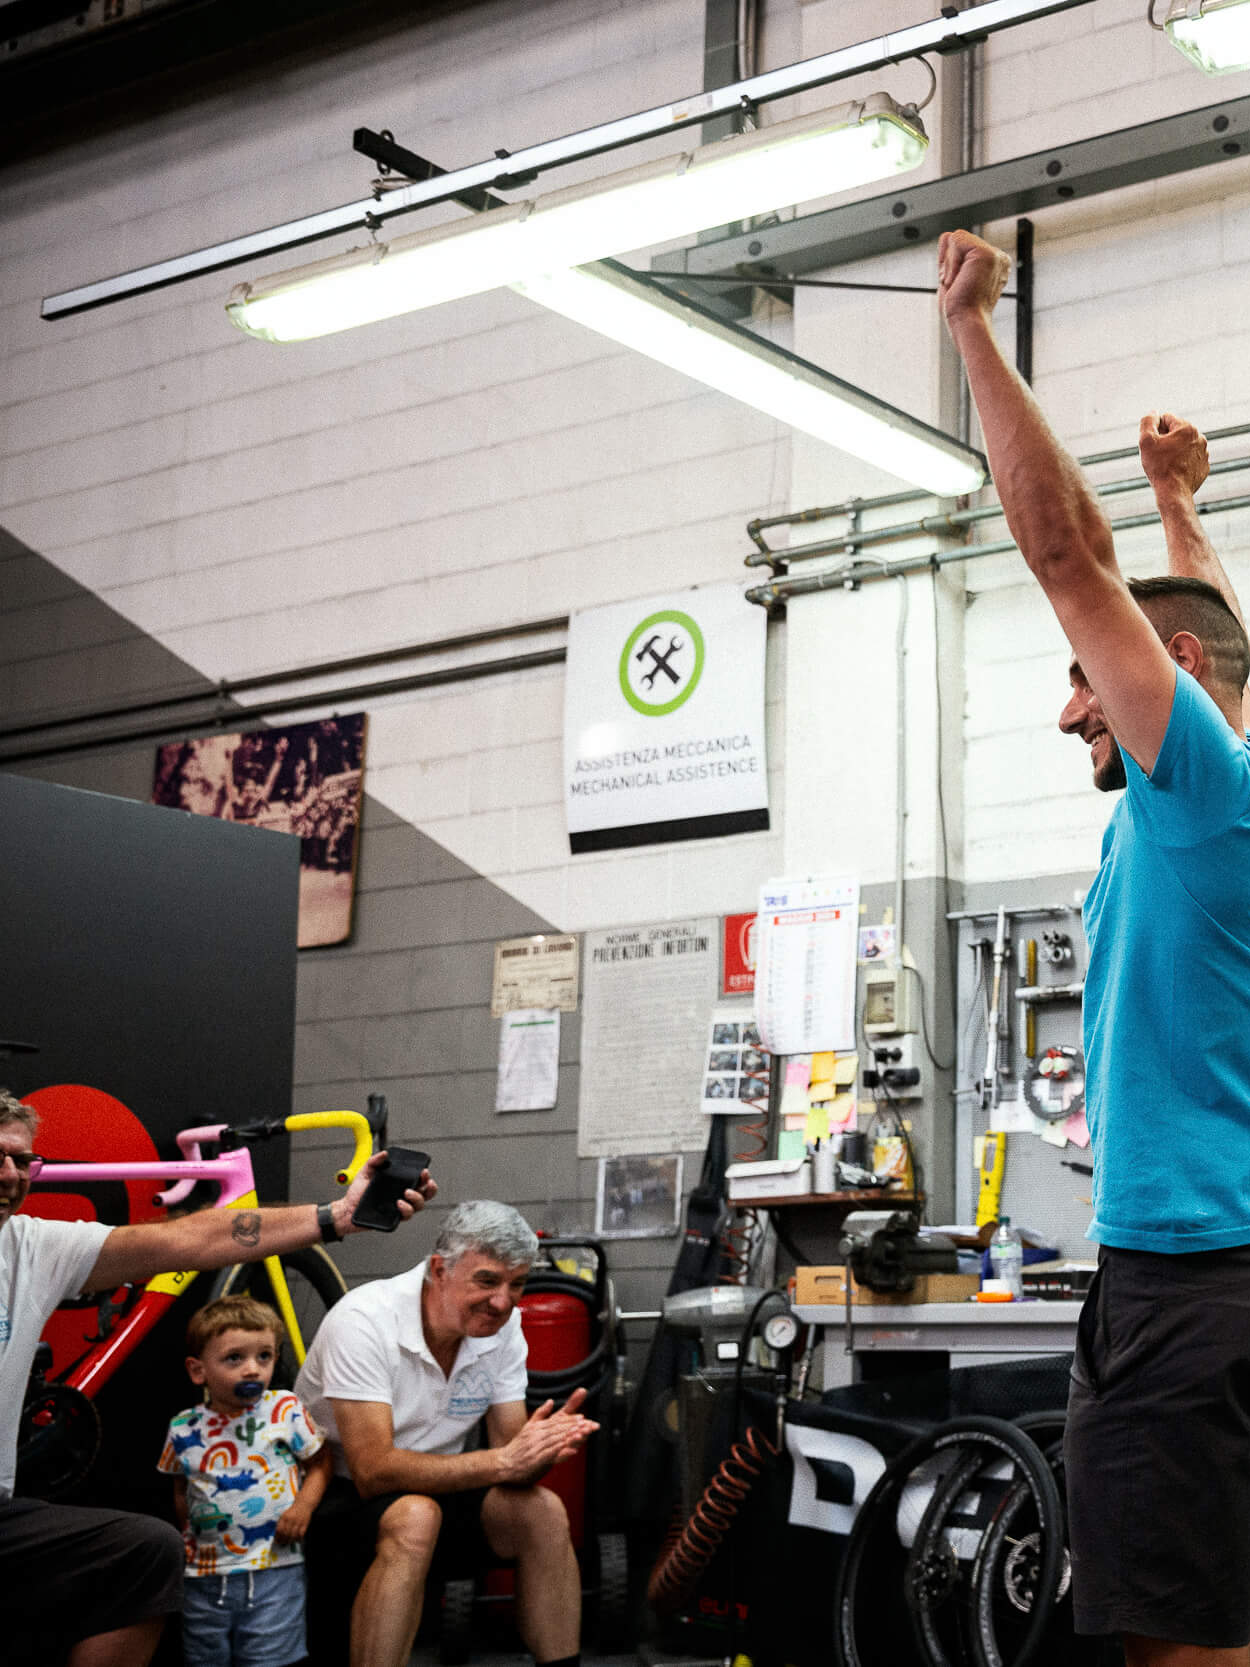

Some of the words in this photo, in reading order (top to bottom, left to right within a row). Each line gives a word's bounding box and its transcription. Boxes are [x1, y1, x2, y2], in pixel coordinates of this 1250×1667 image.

[575, 748, 660, 773] ASSISTENZA
[665, 735, 751, 758] MECCANICA
[570, 775, 662, 796] MECHANICAL
[667, 757, 759, 783] ASSISTENCE
